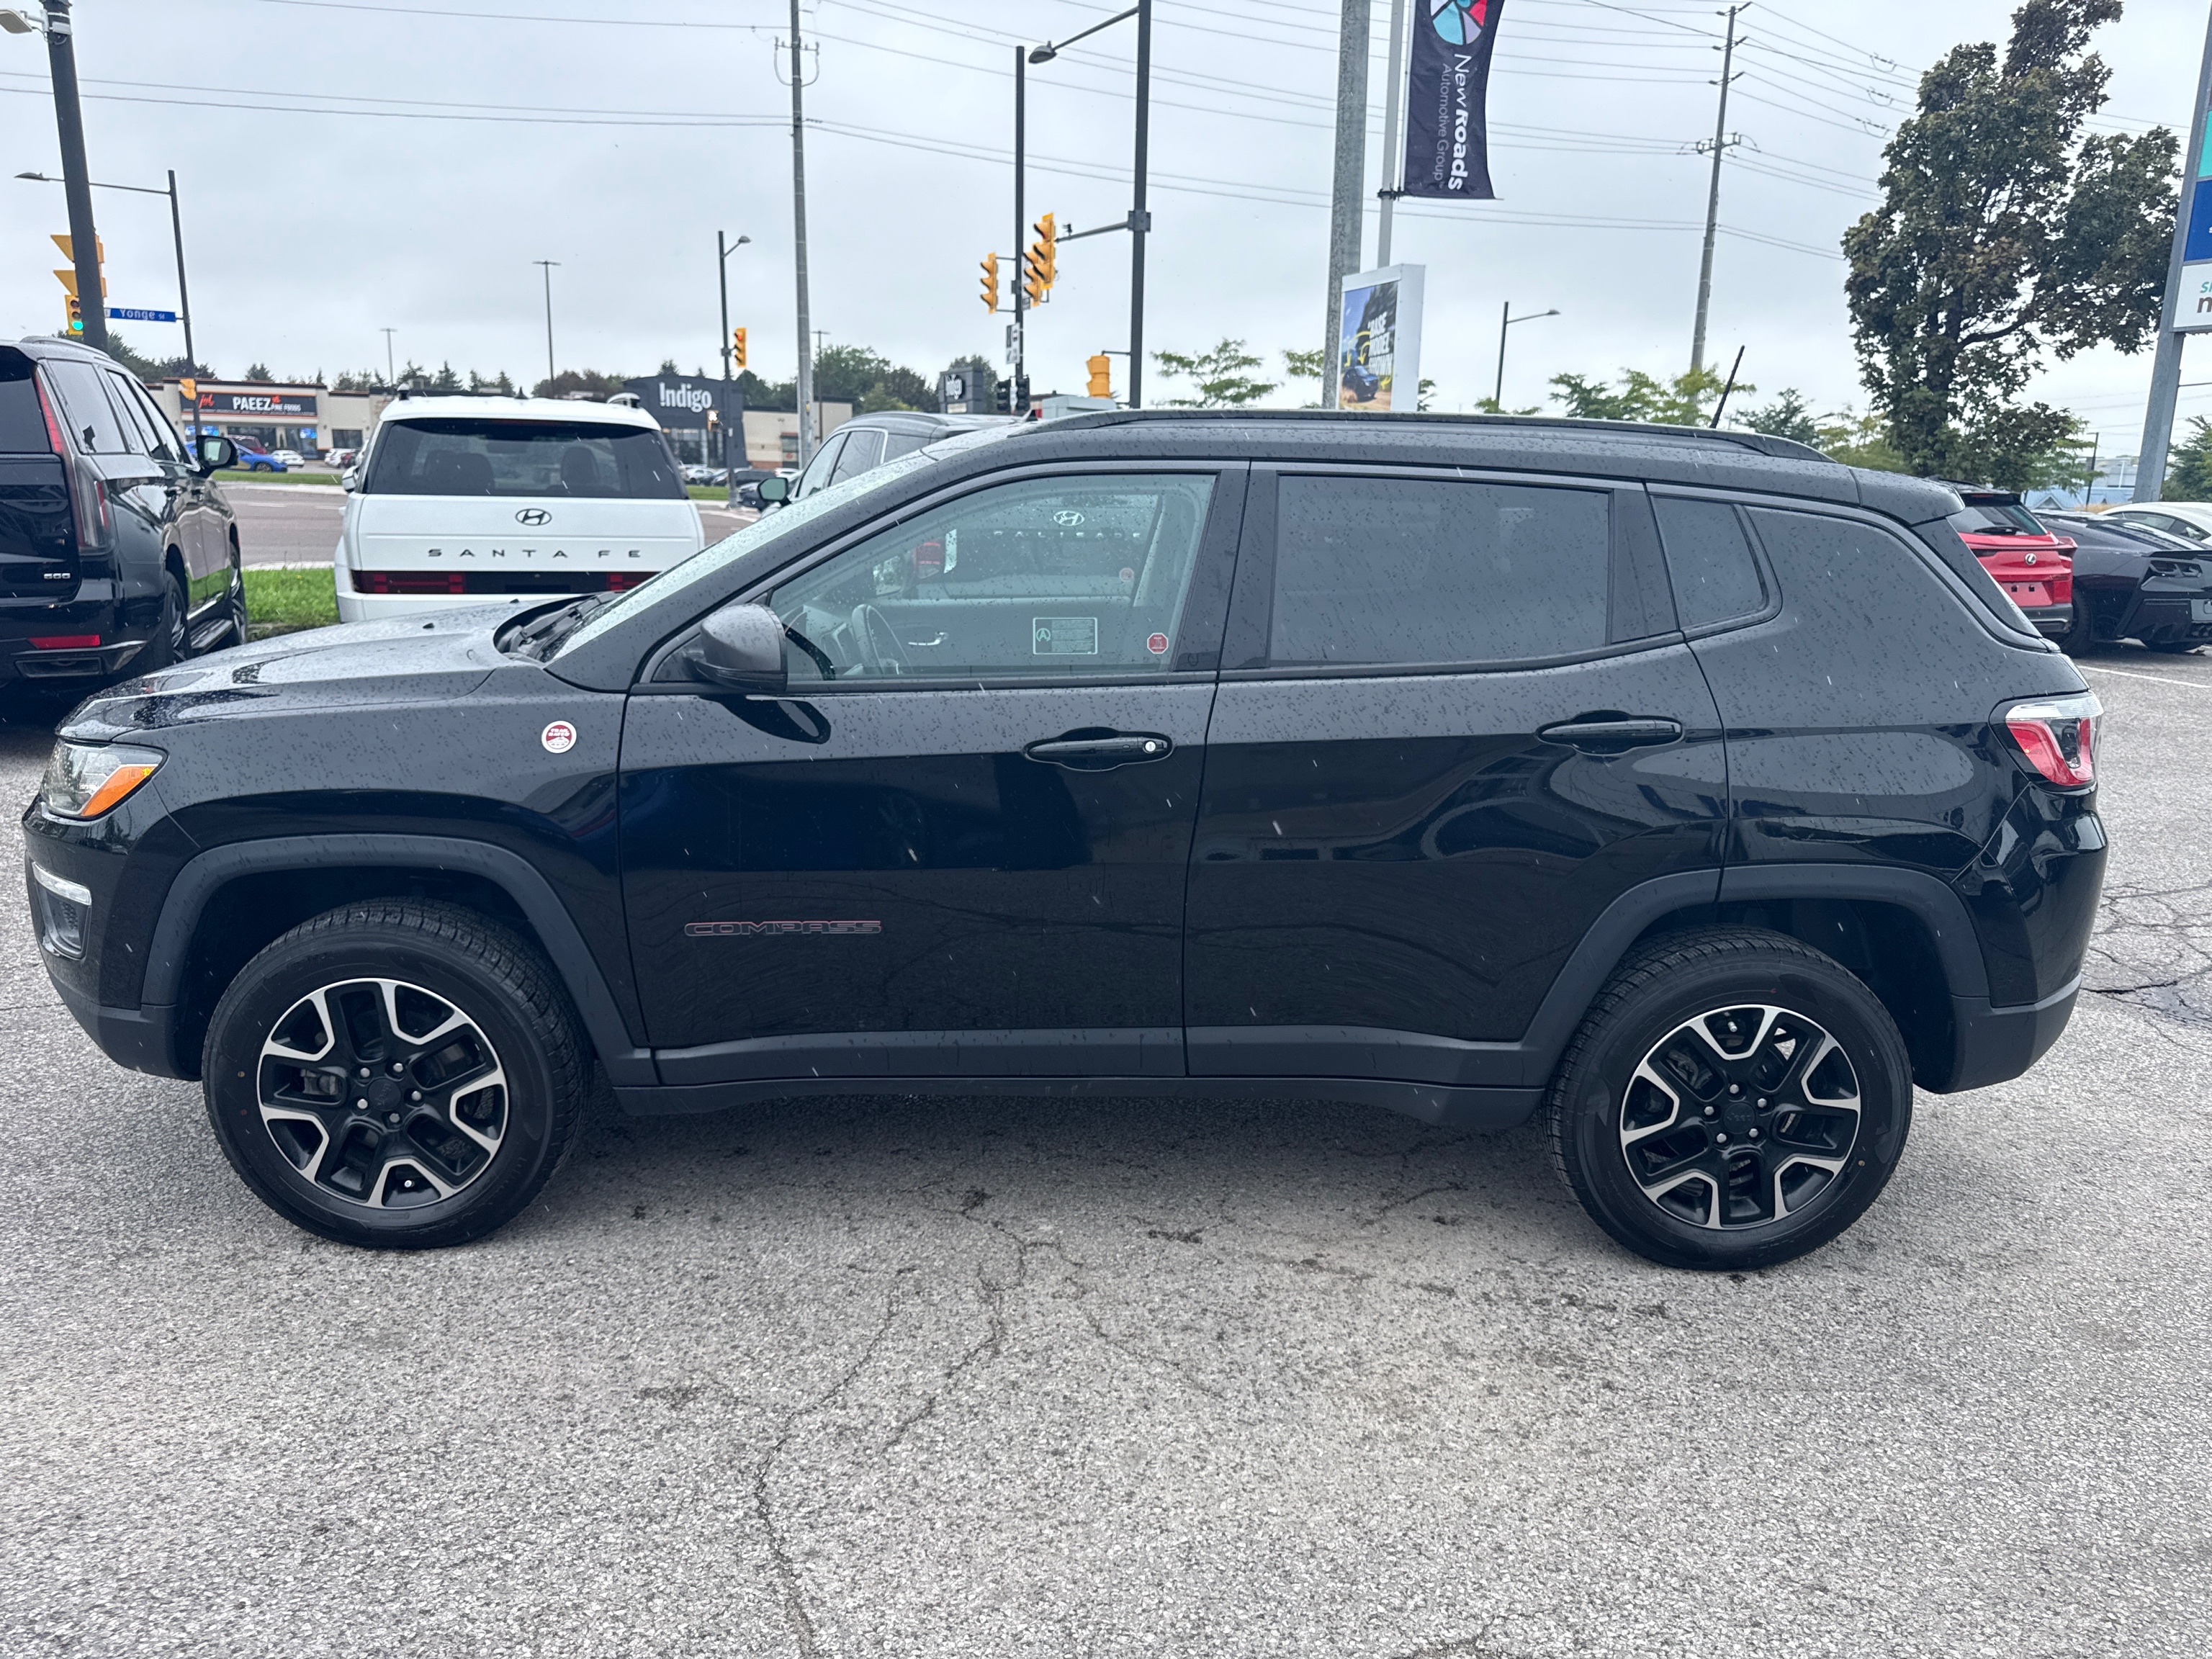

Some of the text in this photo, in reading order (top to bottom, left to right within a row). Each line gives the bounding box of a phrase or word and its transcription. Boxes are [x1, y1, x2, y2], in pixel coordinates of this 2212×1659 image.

[1433, 63, 1452, 181] Automotive Group
[120, 309, 156, 321] Yonge
[233, 396, 271, 411] PAEEZ
[428, 549, 641, 559] SANTA FE
[685, 920, 882, 937] COMPASS
